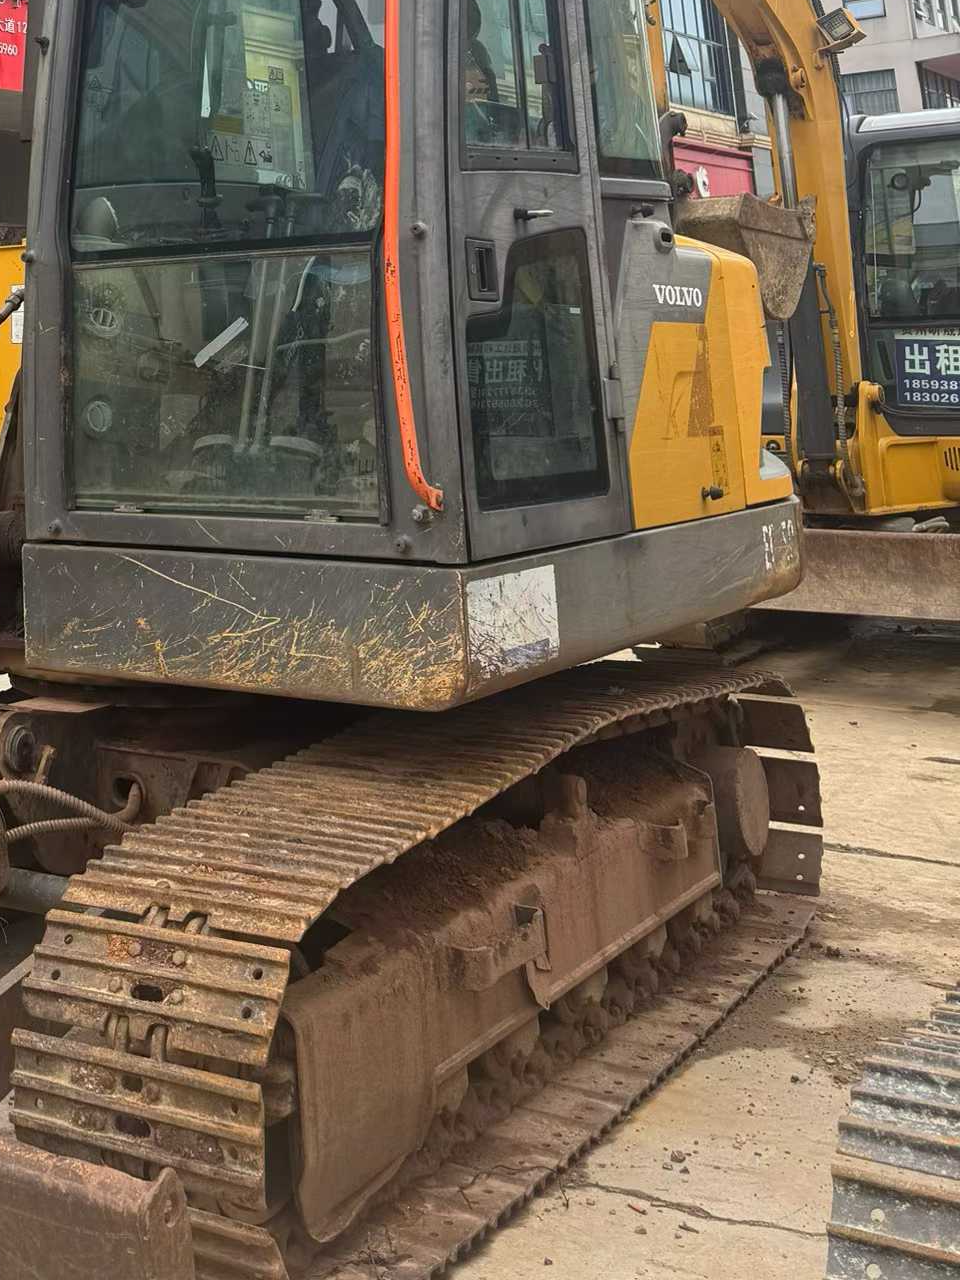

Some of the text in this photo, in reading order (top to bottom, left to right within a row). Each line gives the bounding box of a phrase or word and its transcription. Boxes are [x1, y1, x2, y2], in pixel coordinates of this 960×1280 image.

[653, 283, 703, 308] VOLVO
[904, 343, 960, 376] 出租
[903, 379, 960, 390] 185938
